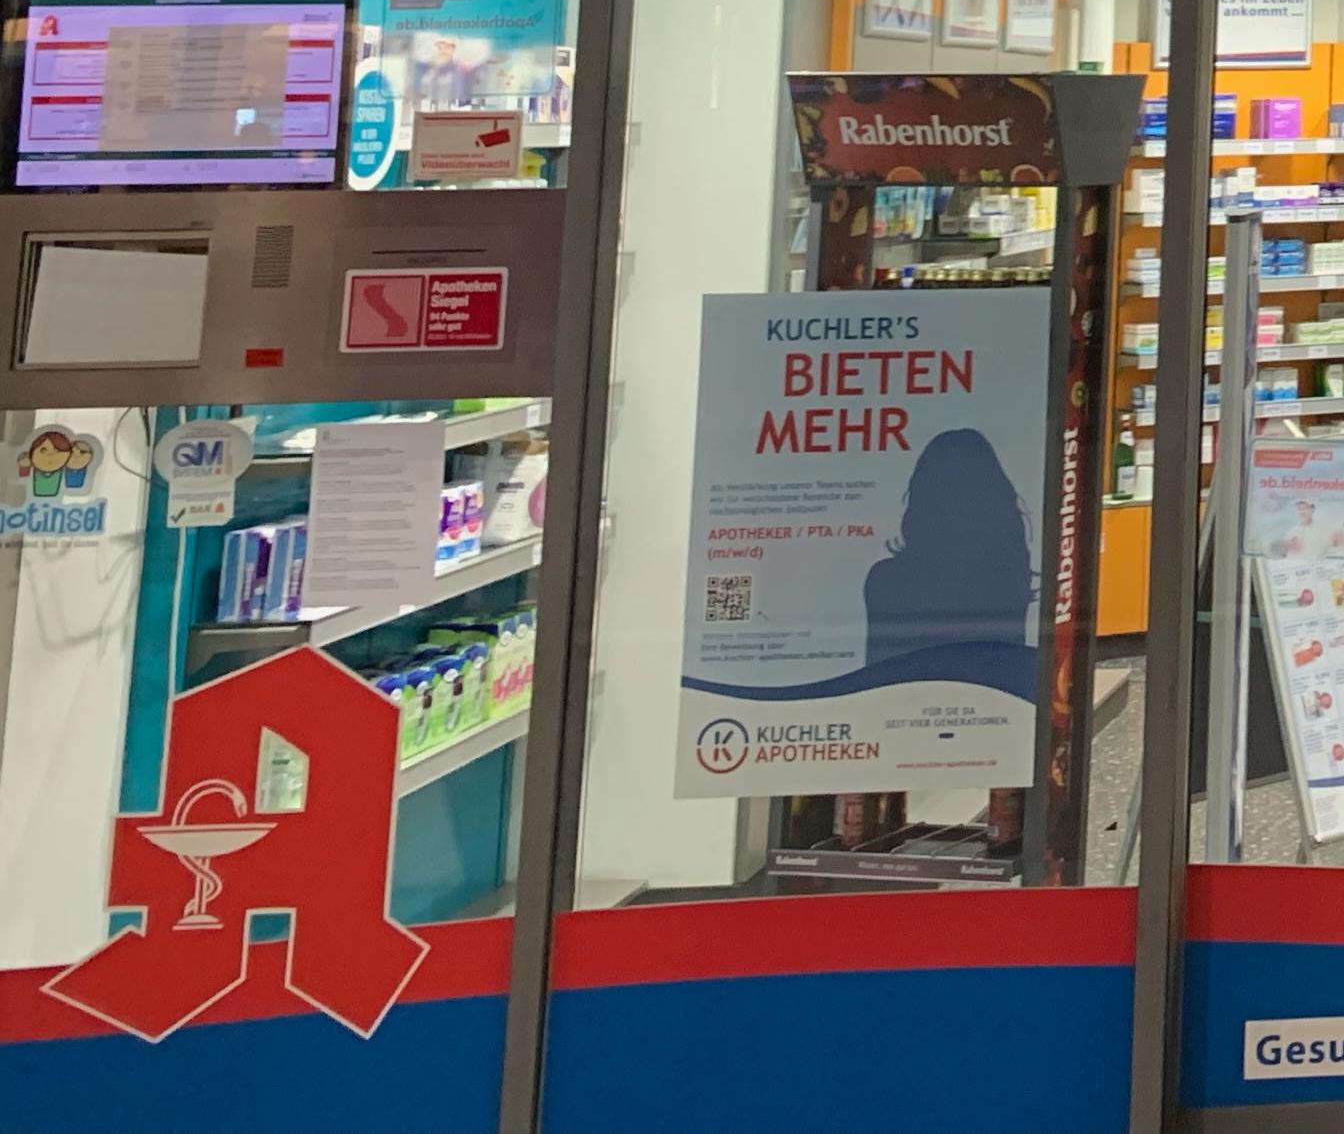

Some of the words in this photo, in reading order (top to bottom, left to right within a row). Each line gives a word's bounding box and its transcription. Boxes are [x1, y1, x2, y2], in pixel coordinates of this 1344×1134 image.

[1223, 6, 1288, 17] ankommt
[838, 113, 1013, 149] Rabenhorst
[432, 280, 497, 294] Apotheken
[430, 295, 470, 310] Siegel
[767, 316, 920, 343] KUCHLER'S
[783, 350, 974, 397] BIETEN
[755, 407, 911, 455] MEHR
[172, 440, 225, 466] QM
[708, 526, 793, 541] APOTHEKER
[807, 525, 834, 538] PTA
[847, 524, 875, 537] PKA
[1055, 426, 1079, 625] Rabenhorst
[707, 545, 764, 561] (m/w/d)
[756, 723, 852, 744] KUCHLER
[755, 741, 880, 764] APOTHEKEN
